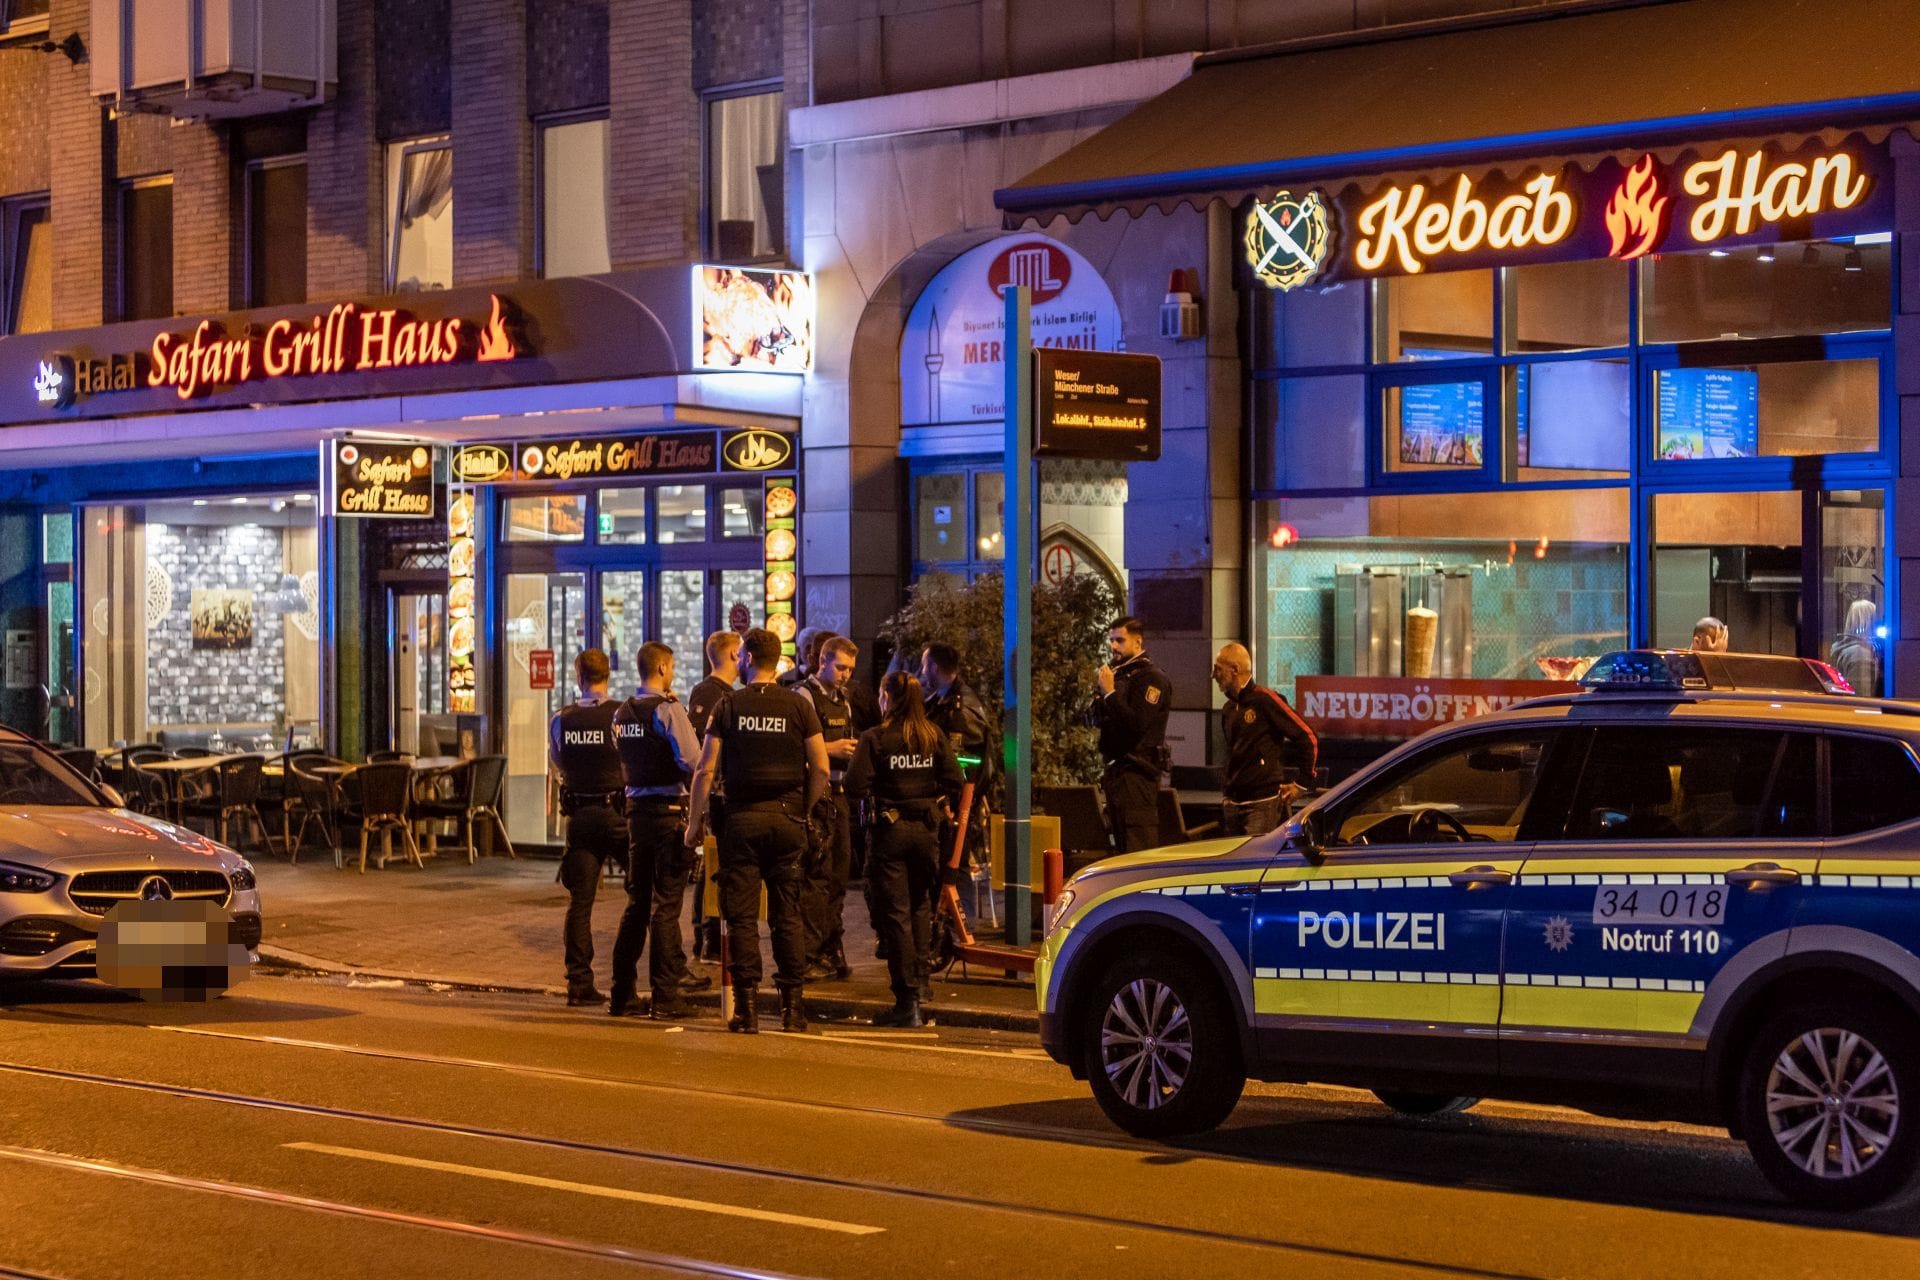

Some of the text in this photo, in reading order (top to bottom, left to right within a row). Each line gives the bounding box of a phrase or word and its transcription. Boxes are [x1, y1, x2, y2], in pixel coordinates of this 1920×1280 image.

[1355, 149, 1866, 273] Kebab Han
[75, 302, 461, 399] Halal Safari Grill Haus
[359, 456, 412, 484] Safari
[461, 451, 499, 475] Halal
[544, 436, 711, 480] Safari Grill Haus
[341, 485, 429, 512] Grill Haus
[565, 731, 604, 744] POLIZEI
[615, 723, 644, 738] POLIZEI
[738, 716, 786, 733] POLIZEI
[890, 754, 933, 770] POLIZEI
[1599, 888, 1722, 918] 34 018
[1297, 910, 1446, 951] POLIZEI
[1601, 926, 1720, 954] Notruf 110
